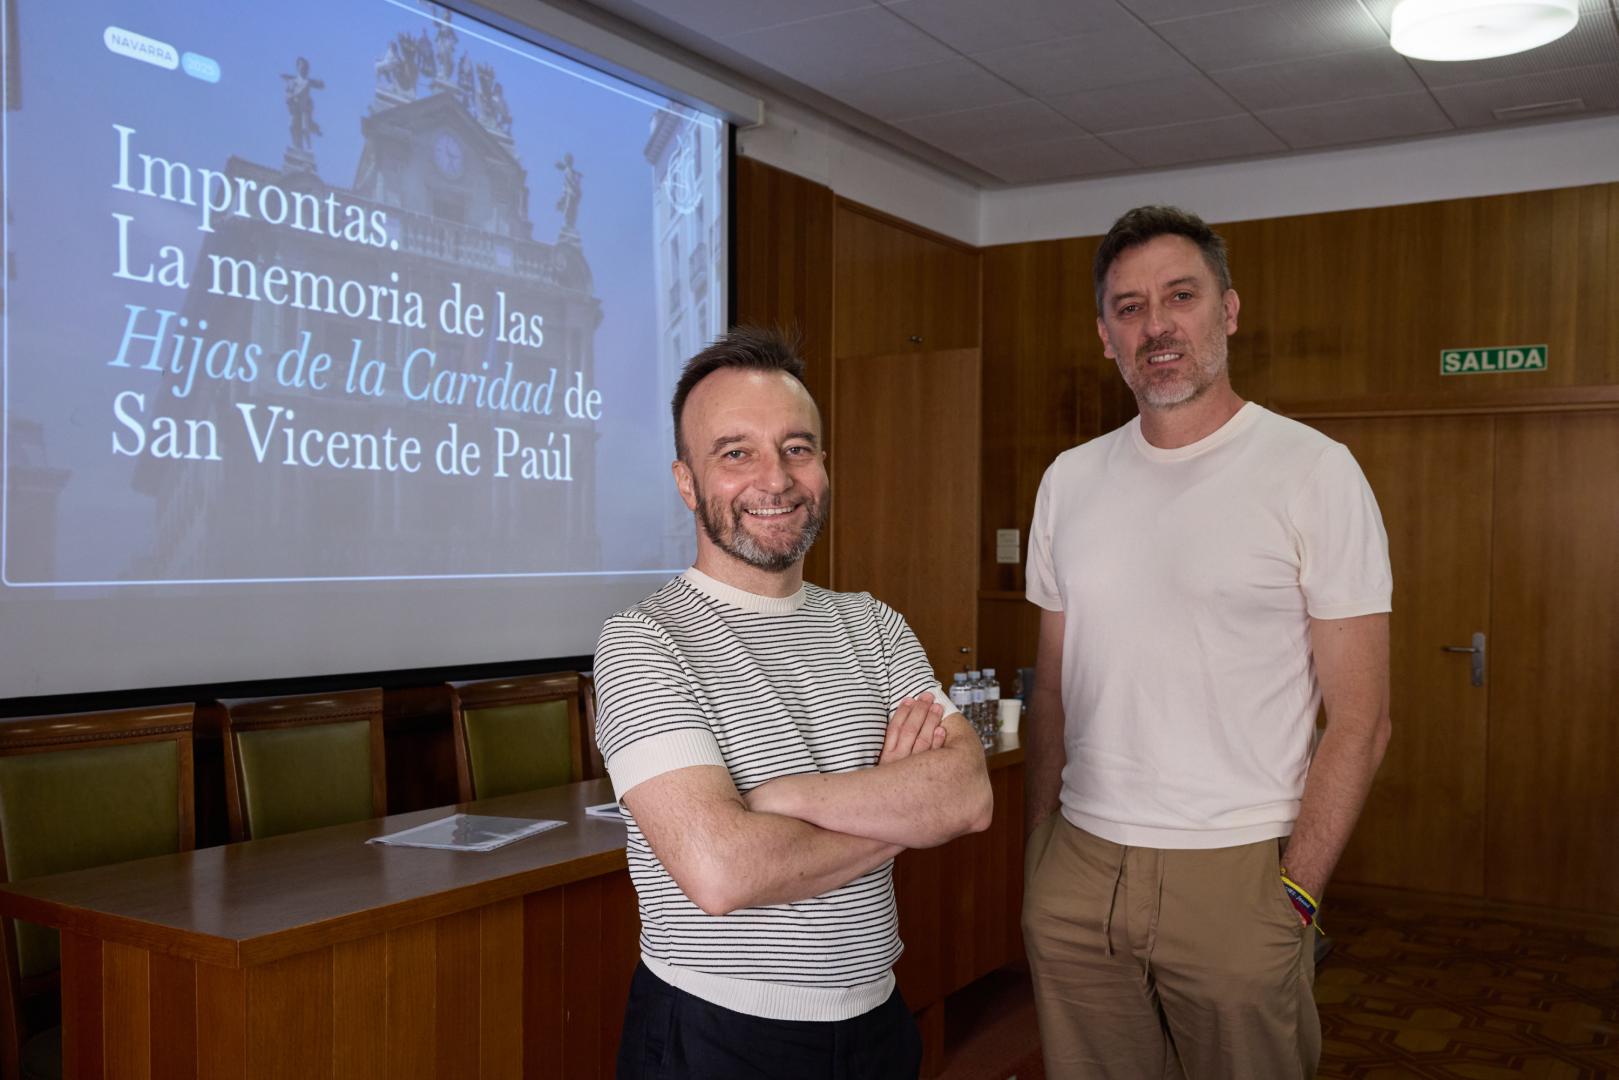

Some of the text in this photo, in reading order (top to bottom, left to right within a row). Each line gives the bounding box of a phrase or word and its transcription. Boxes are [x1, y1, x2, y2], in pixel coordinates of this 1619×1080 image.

[111, 33, 172, 62] NAVARRA
[112, 123, 399, 250] Improntas.
[112, 212, 544, 348] La memoria de las
[107, 304, 603, 421] Hijas de la Caridad de
[1445, 349, 1543, 372] SALIDA
[112, 390, 574, 482] San Vicente de Paúl
